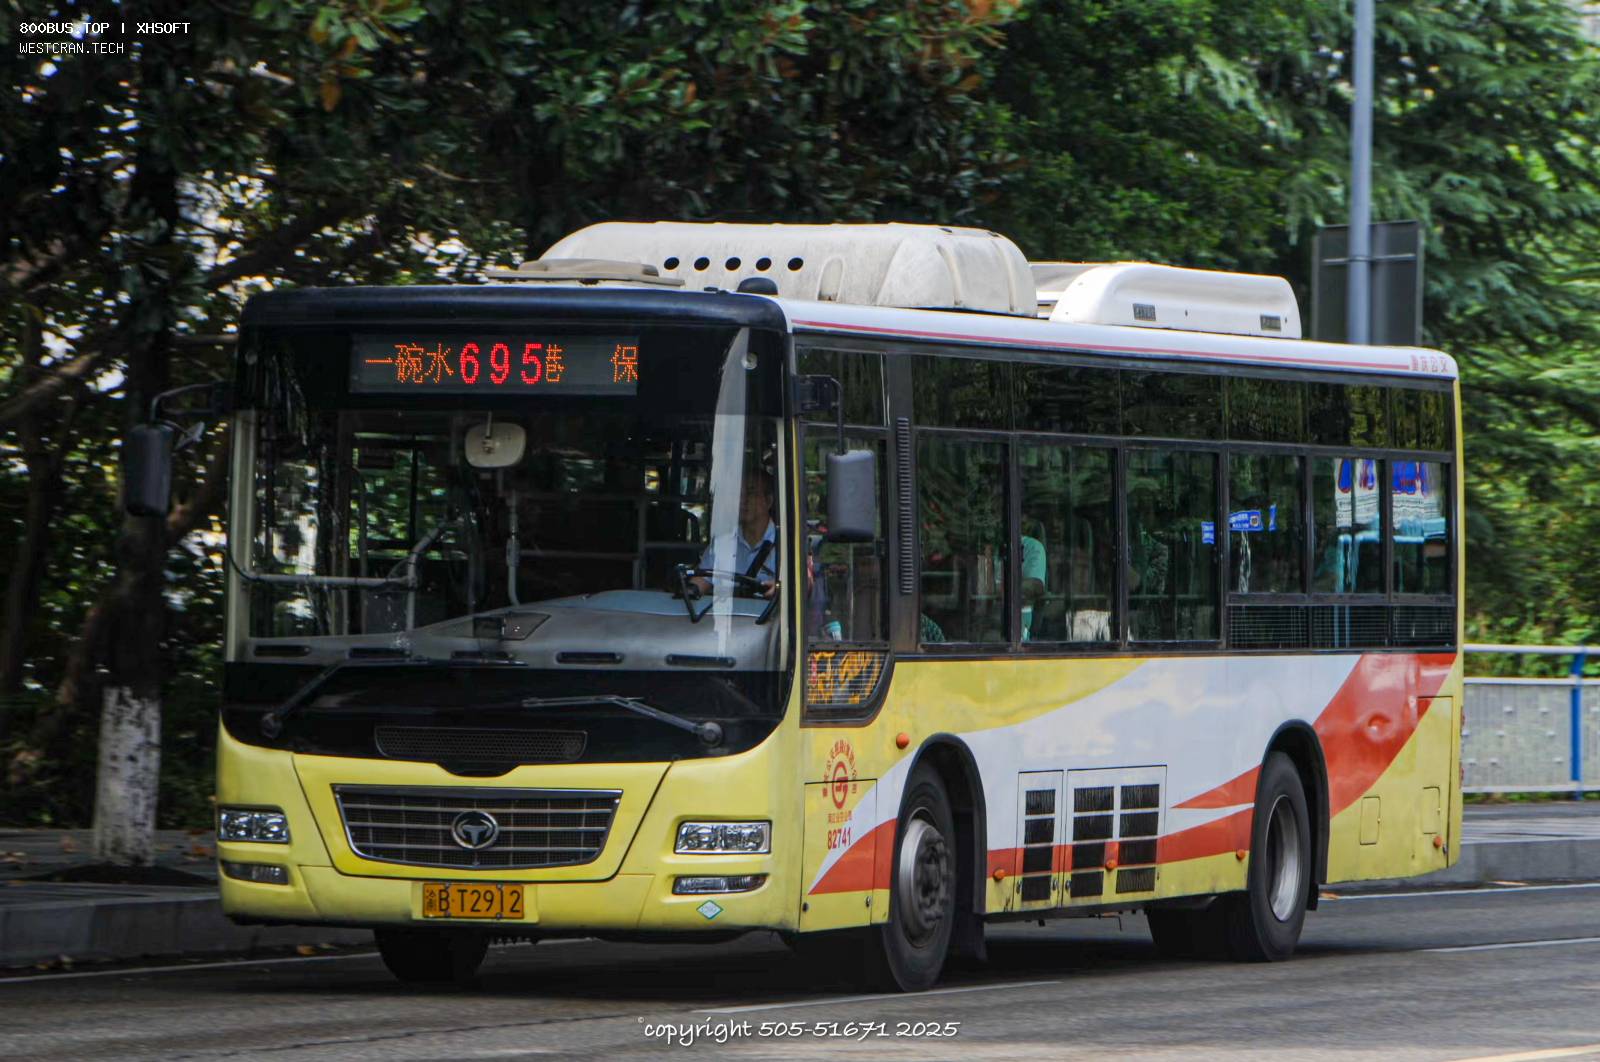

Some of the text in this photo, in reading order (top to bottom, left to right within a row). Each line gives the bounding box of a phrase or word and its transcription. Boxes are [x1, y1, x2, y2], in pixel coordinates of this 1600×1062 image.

[365, 343, 455, 383] 一碗水
[460, 343, 543, 384] 695
[610, 343, 639, 383] 保
[828, 827, 851, 849] 82741
